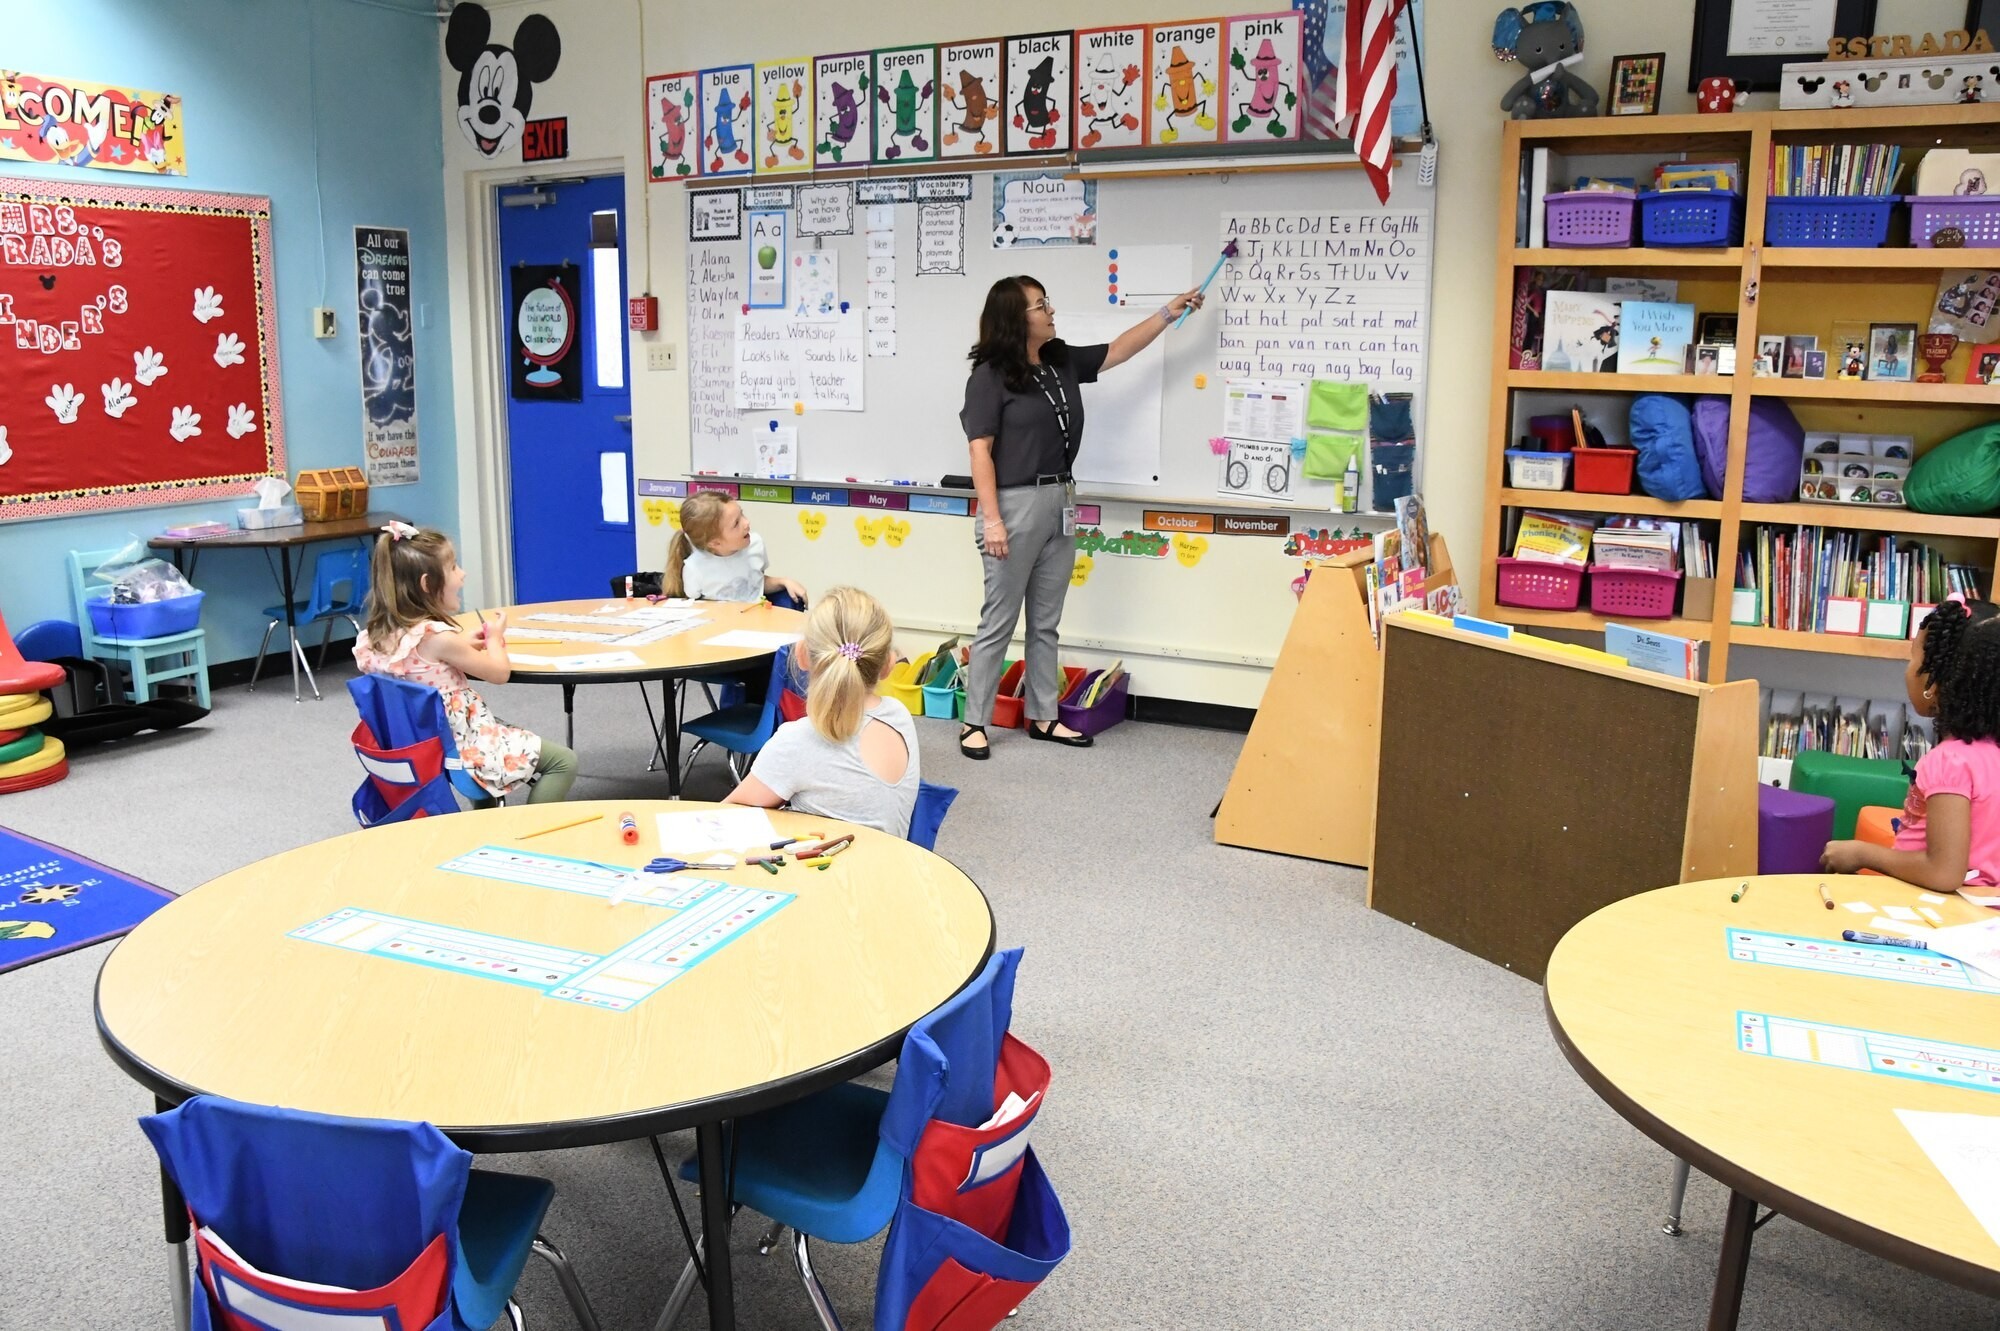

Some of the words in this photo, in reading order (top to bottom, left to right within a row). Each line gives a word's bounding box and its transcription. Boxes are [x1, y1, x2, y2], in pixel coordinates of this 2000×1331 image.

[1155, 26, 1216, 45] orange
[1244, 20, 1284, 39] pink
[1018, 37, 1060, 55] black
[1089, 31, 1134, 48] white
[1827, 28, 1994, 60] ESTRADA
[948, 46, 994, 62] brown
[820, 58, 865, 77] purple
[883, 53, 925, 71] green
[712, 72, 740, 87] blue
[763, 65, 805, 81] yellow
[661, 79, 682, 93] red
[523, 120, 565, 159] EXIT
[920, 180, 964, 189] Vocabulary
[1022, 181, 1066, 194] Noun
[753, 190, 784, 198] Essential
[929, 188, 955, 196] Words
[810, 197, 827, 206] Why
[829, 196, 839, 204] do
[821, 205, 841, 213] have
[812, 216, 837, 224] rules?
[754, 221, 766, 238] A
[771, 225, 781, 237] a
[366, 233, 381, 248] All
[384, 239, 400, 248] our
[874, 239, 888, 249] like
[700, 249, 731, 266] Alana
[925, 249, 953, 258] playmate
[362, 269, 379, 280] can
[382, 269, 406, 281] come
[875, 266, 887, 277] go
[386, 283, 406, 296] true
[699, 286, 740, 306] Waylon
[875, 288, 888, 299] the
[525, 302, 535, 312] The
[536, 302, 555, 312] future
[555, 302, 562, 312] of
[630, 301, 646, 315] FIRE
[527, 313, 540, 322] this
[701, 307, 725, 321] Olin
[875, 315, 889, 324] see
[1649, 310, 1675, 321] Wish
[1224, 309, 1250, 326] bat
[1259, 309, 1287, 327] hat
[1301, 310, 1323, 333] pat
[1332, 311, 1354, 328] sat
[1362, 311, 1384, 328] rat
[1394, 311, 1419, 329] mat
[1632, 321, 1652, 333] You
[1655, 322, 1683, 334] More
[543, 326, 554, 336] my
[743, 322, 780, 341] Readers
[787, 322, 836, 343] Workshop
[876, 340, 889, 349] we
[1220, 331, 1245, 348] ban
[1255, 338, 1280, 355] pan
[1288, 339, 1315, 351] van
[1324, 340, 1351, 351] ran
[1359, 341, 1386, 352] can
[1393, 335, 1420, 353] tan
[742, 350, 771, 362] Looks
[773, 350, 790, 362] like
[804, 349, 836, 362] Sounds
[839, 347, 858, 362] like
[701, 360, 733, 376] Harper
[1220, 360, 1251, 377] wag
[1259, 355, 1283, 377] tag
[1292, 361, 1316, 378] rag
[1325, 363, 1351, 381] nag
[1358, 358, 1382, 380] bag
[1391, 358, 1413, 381] lag
[810, 370, 845, 386] teacher
[700, 389, 725, 403] David
[743, 388, 776, 406] sitting
[781, 391, 789, 399] in
[813, 389, 850, 405] talking
[376, 432, 385, 442] we
[387, 430, 403, 441] have
[404, 429, 416, 440] the
[704, 417, 738, 441] Sophia
[1236, 443, 1260, 451] THUMBS
[378, 461, 399, 473] pursue
[400, 459, 416, 469] them
[648, 483, 677, 495] January
[753, 487, 778, 499] March
[811, 491, 831, 504] April
[868, 494, 888, 507] May
[927, 499, 949, 510] June
[1157, 516, 1199, 528] October
[1224, 518, 1279, 531] November
[1541, 522, 1563, 532] SUPER
[1522, 528, 1558, 539] Phonics
[1646, 637, 1661, 648] Seuss
